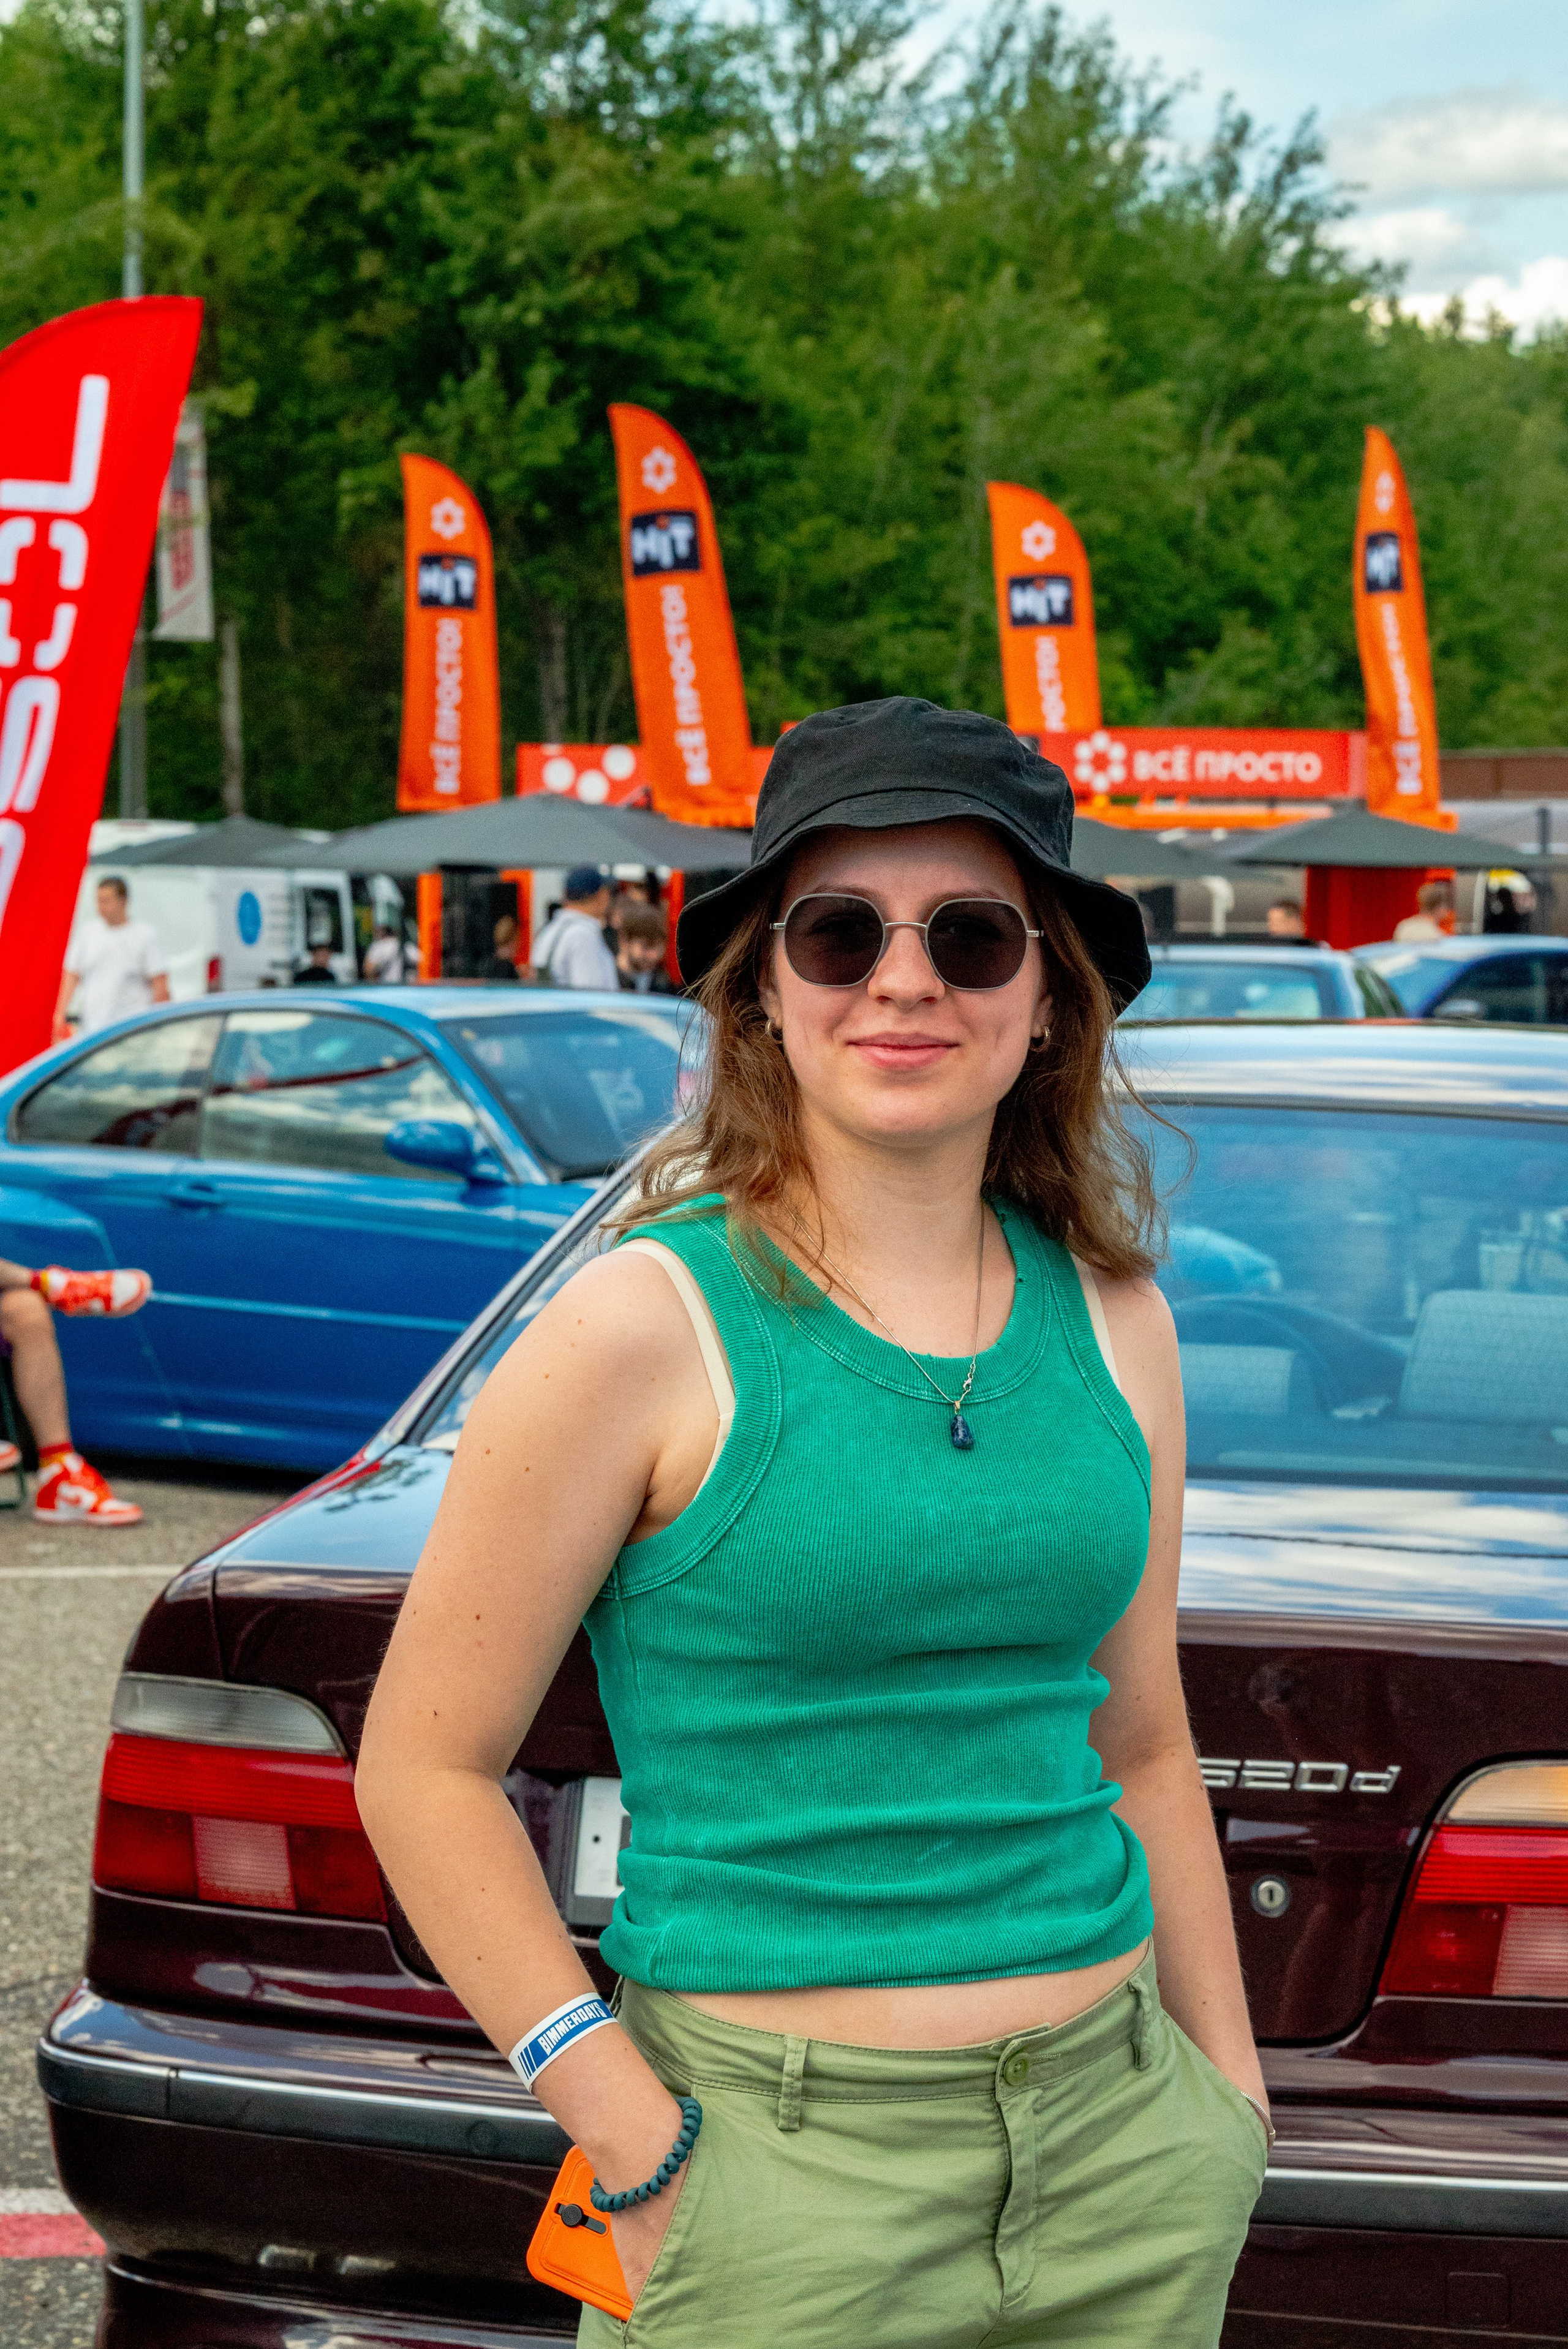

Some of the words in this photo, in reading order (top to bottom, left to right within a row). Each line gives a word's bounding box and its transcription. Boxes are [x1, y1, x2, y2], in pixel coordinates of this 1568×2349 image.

[1133, 744, 1191, 782] ВСЁ
[1194, 750, 1322, 783] ПРОСТО
[1197, 1757, 1401, 1793] 520d
[537, 2001, 608, 2056] BIMMERDAYS
